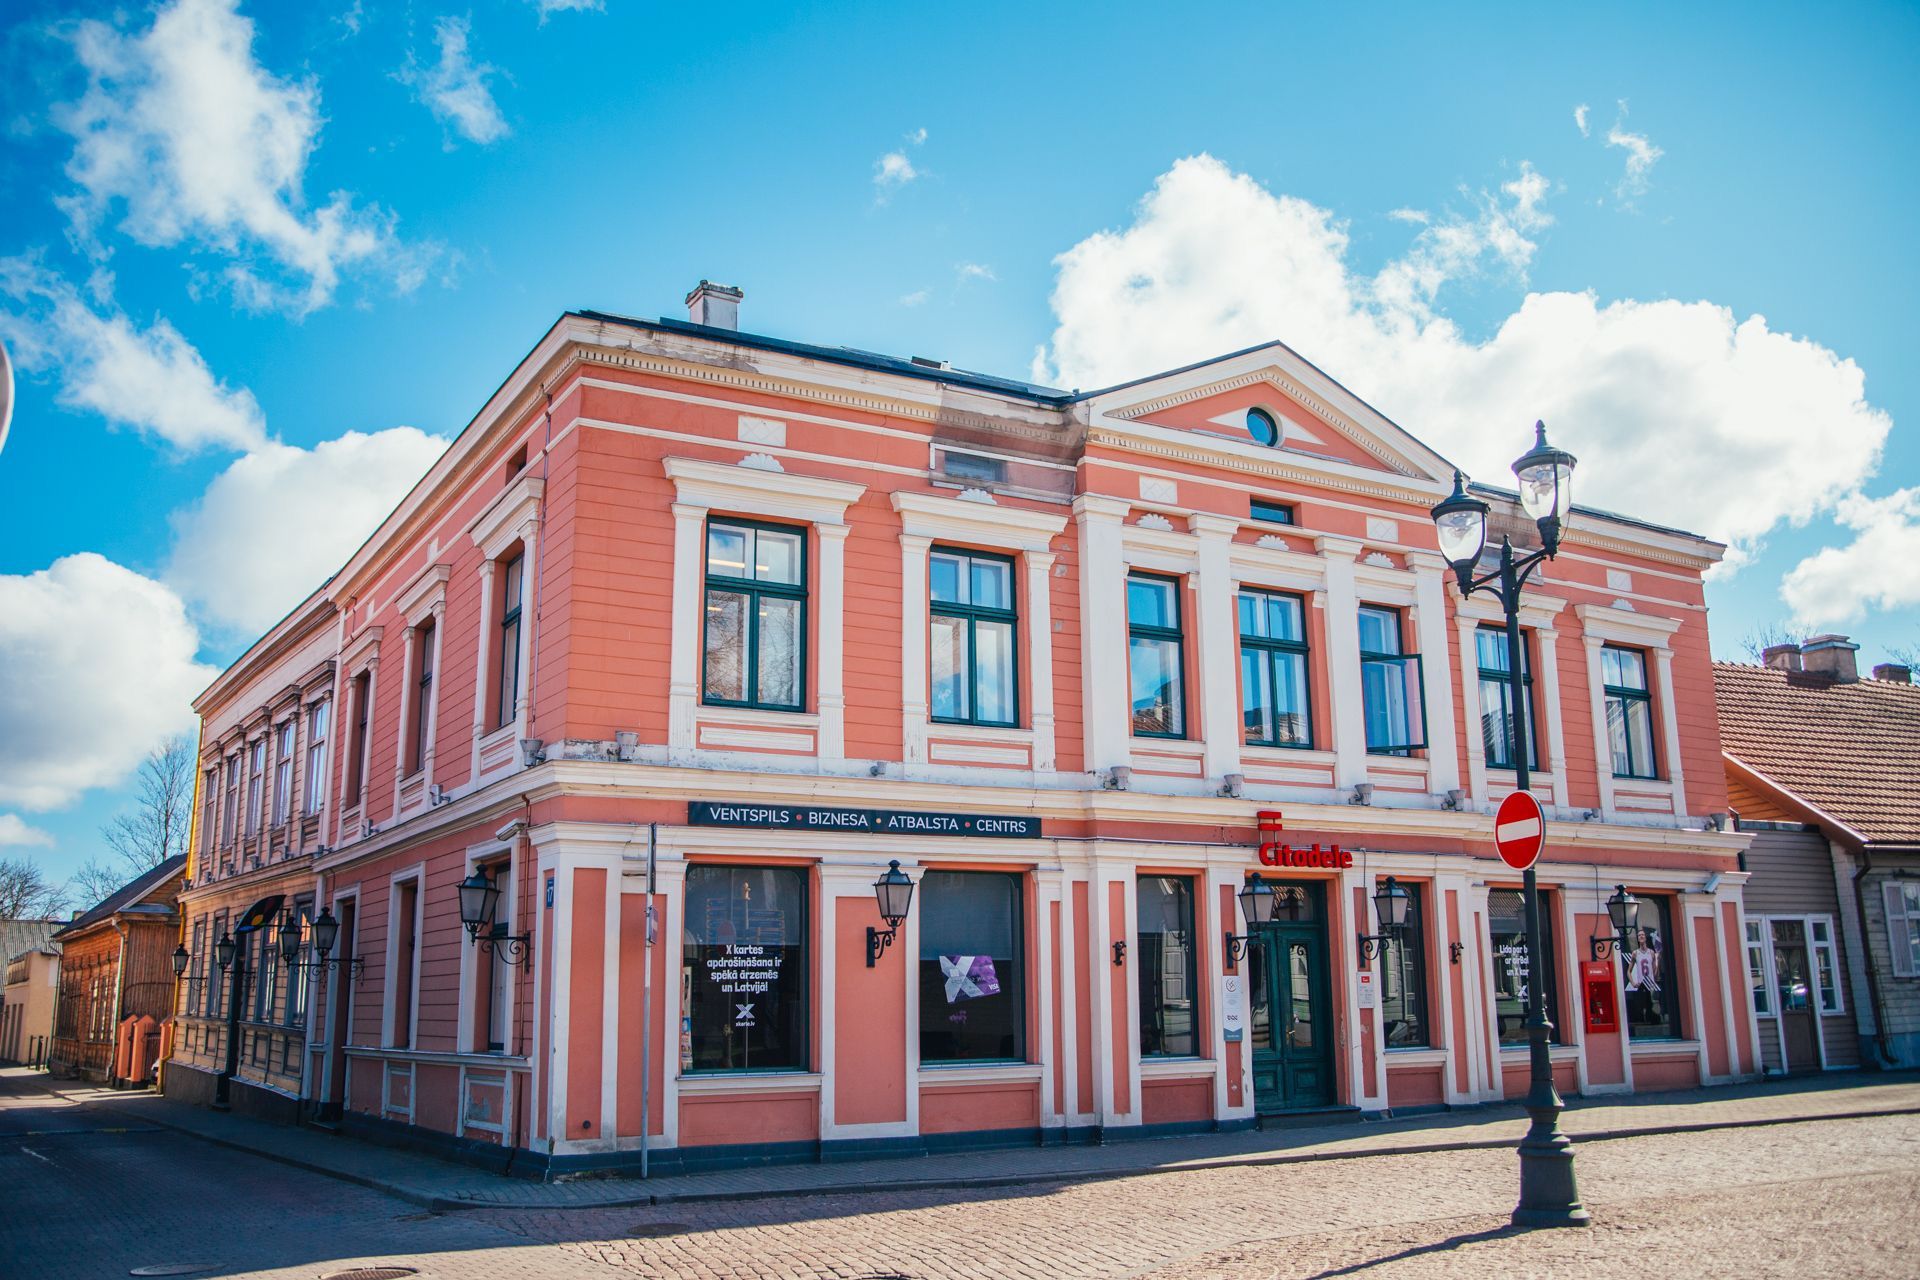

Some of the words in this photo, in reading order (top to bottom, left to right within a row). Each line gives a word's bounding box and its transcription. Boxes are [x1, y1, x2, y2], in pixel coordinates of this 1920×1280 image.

[709, 806, 789, 824] VENTSPILS
[808, 811, 868, 827] BIZNESA
[888, 814, 959, 831] ATBALSTA
[976, 818, 1027, 833] CENTRS
[1258, 841, 1353, 869] Citadele
[547, 887, 553, 902] 17
[726, 944, 732, 955] X
[733, 944, 764, 955] kartes
[706, 957, 773, 969] apdrošināšana
[774, 956, 782, 967] ir
[1641, 958, 1649, 976] 6
[710, 969, 738, 982] spēkā
[739, 969, 779, 980] ārzemēs
[734, 981, 769, 994] Latvijā!
